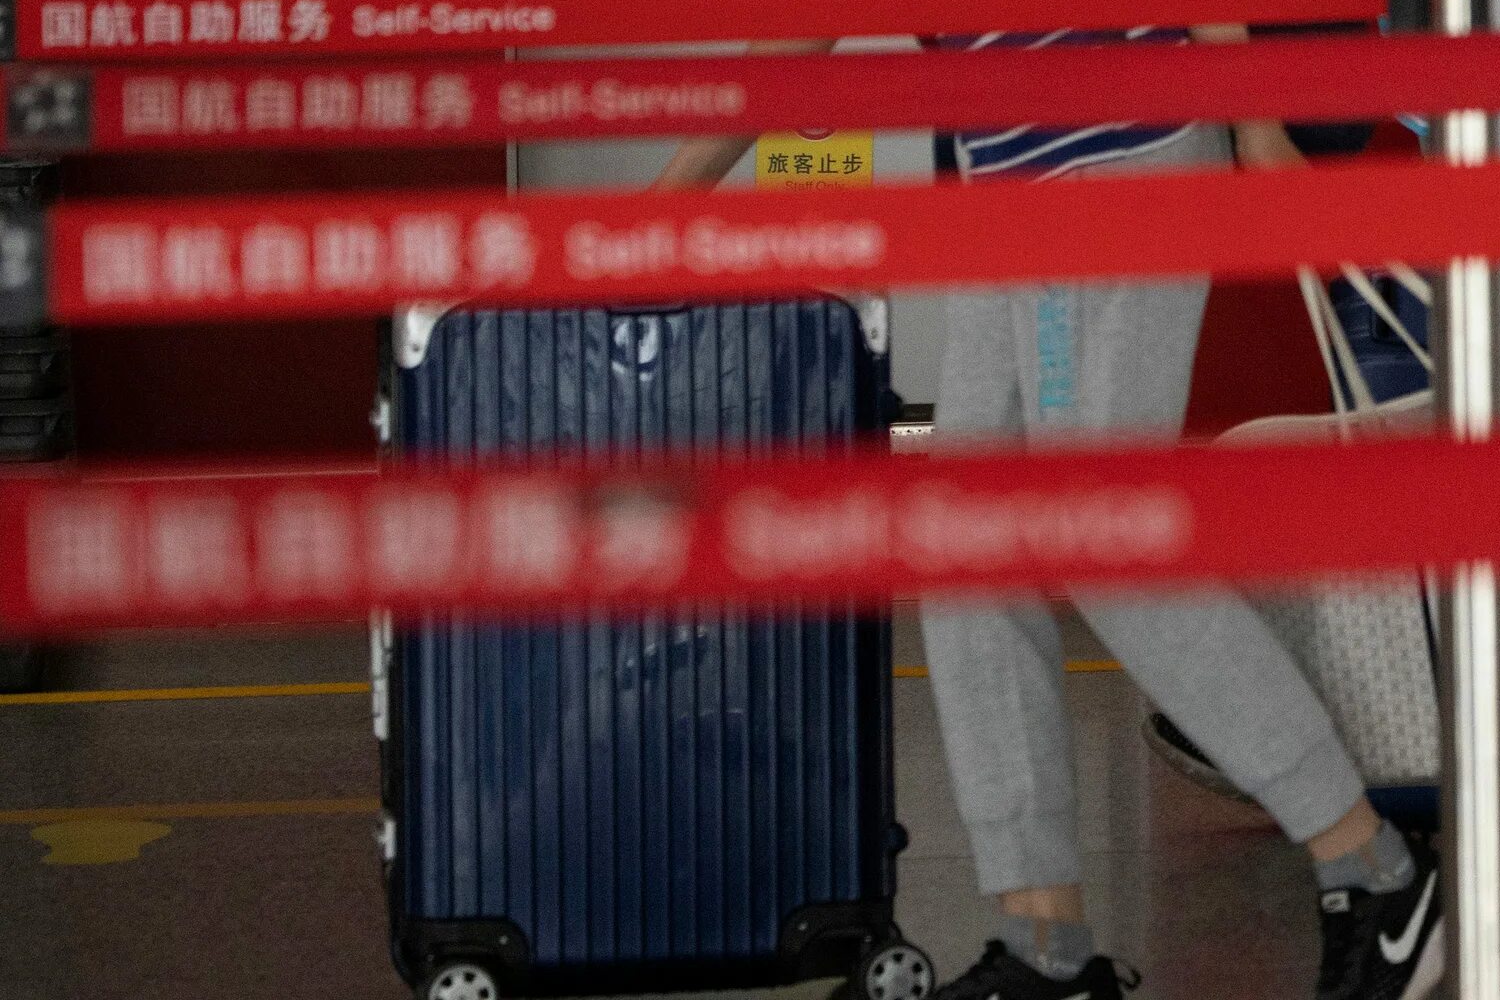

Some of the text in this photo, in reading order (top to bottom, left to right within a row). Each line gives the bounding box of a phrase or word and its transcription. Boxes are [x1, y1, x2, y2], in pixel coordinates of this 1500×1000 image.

[351, 3, 556, 38] Self-Service
[768, 153, 863, 174] 旅客止步
